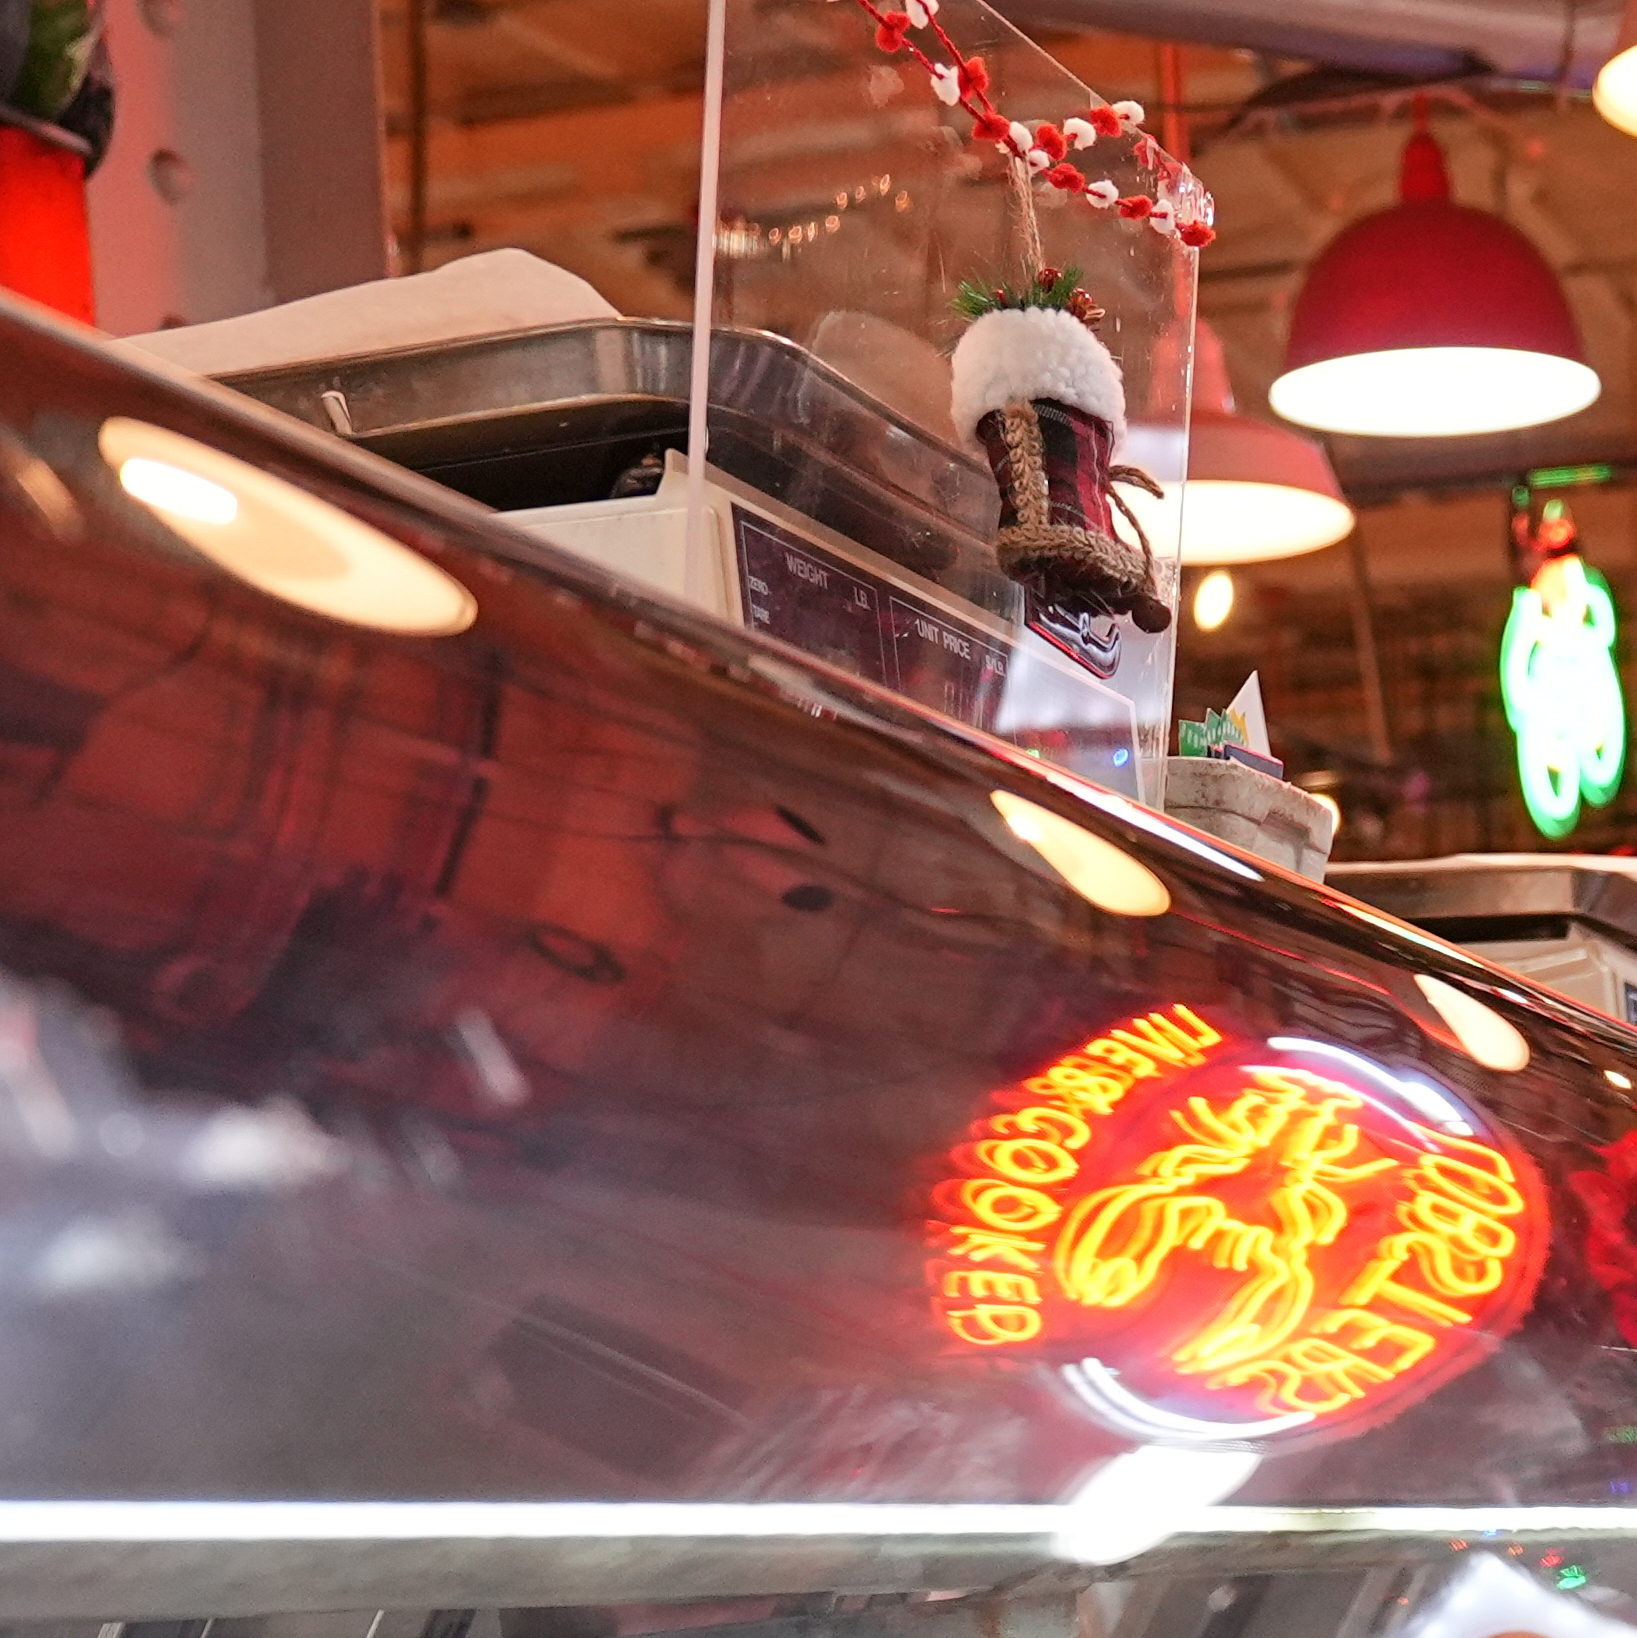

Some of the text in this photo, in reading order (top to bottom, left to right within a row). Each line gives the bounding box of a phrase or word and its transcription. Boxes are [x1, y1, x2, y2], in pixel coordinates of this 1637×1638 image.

[785, 552, 830, 590] WEIGHT
[915, 617, 972, 660] UNIT PRICE
